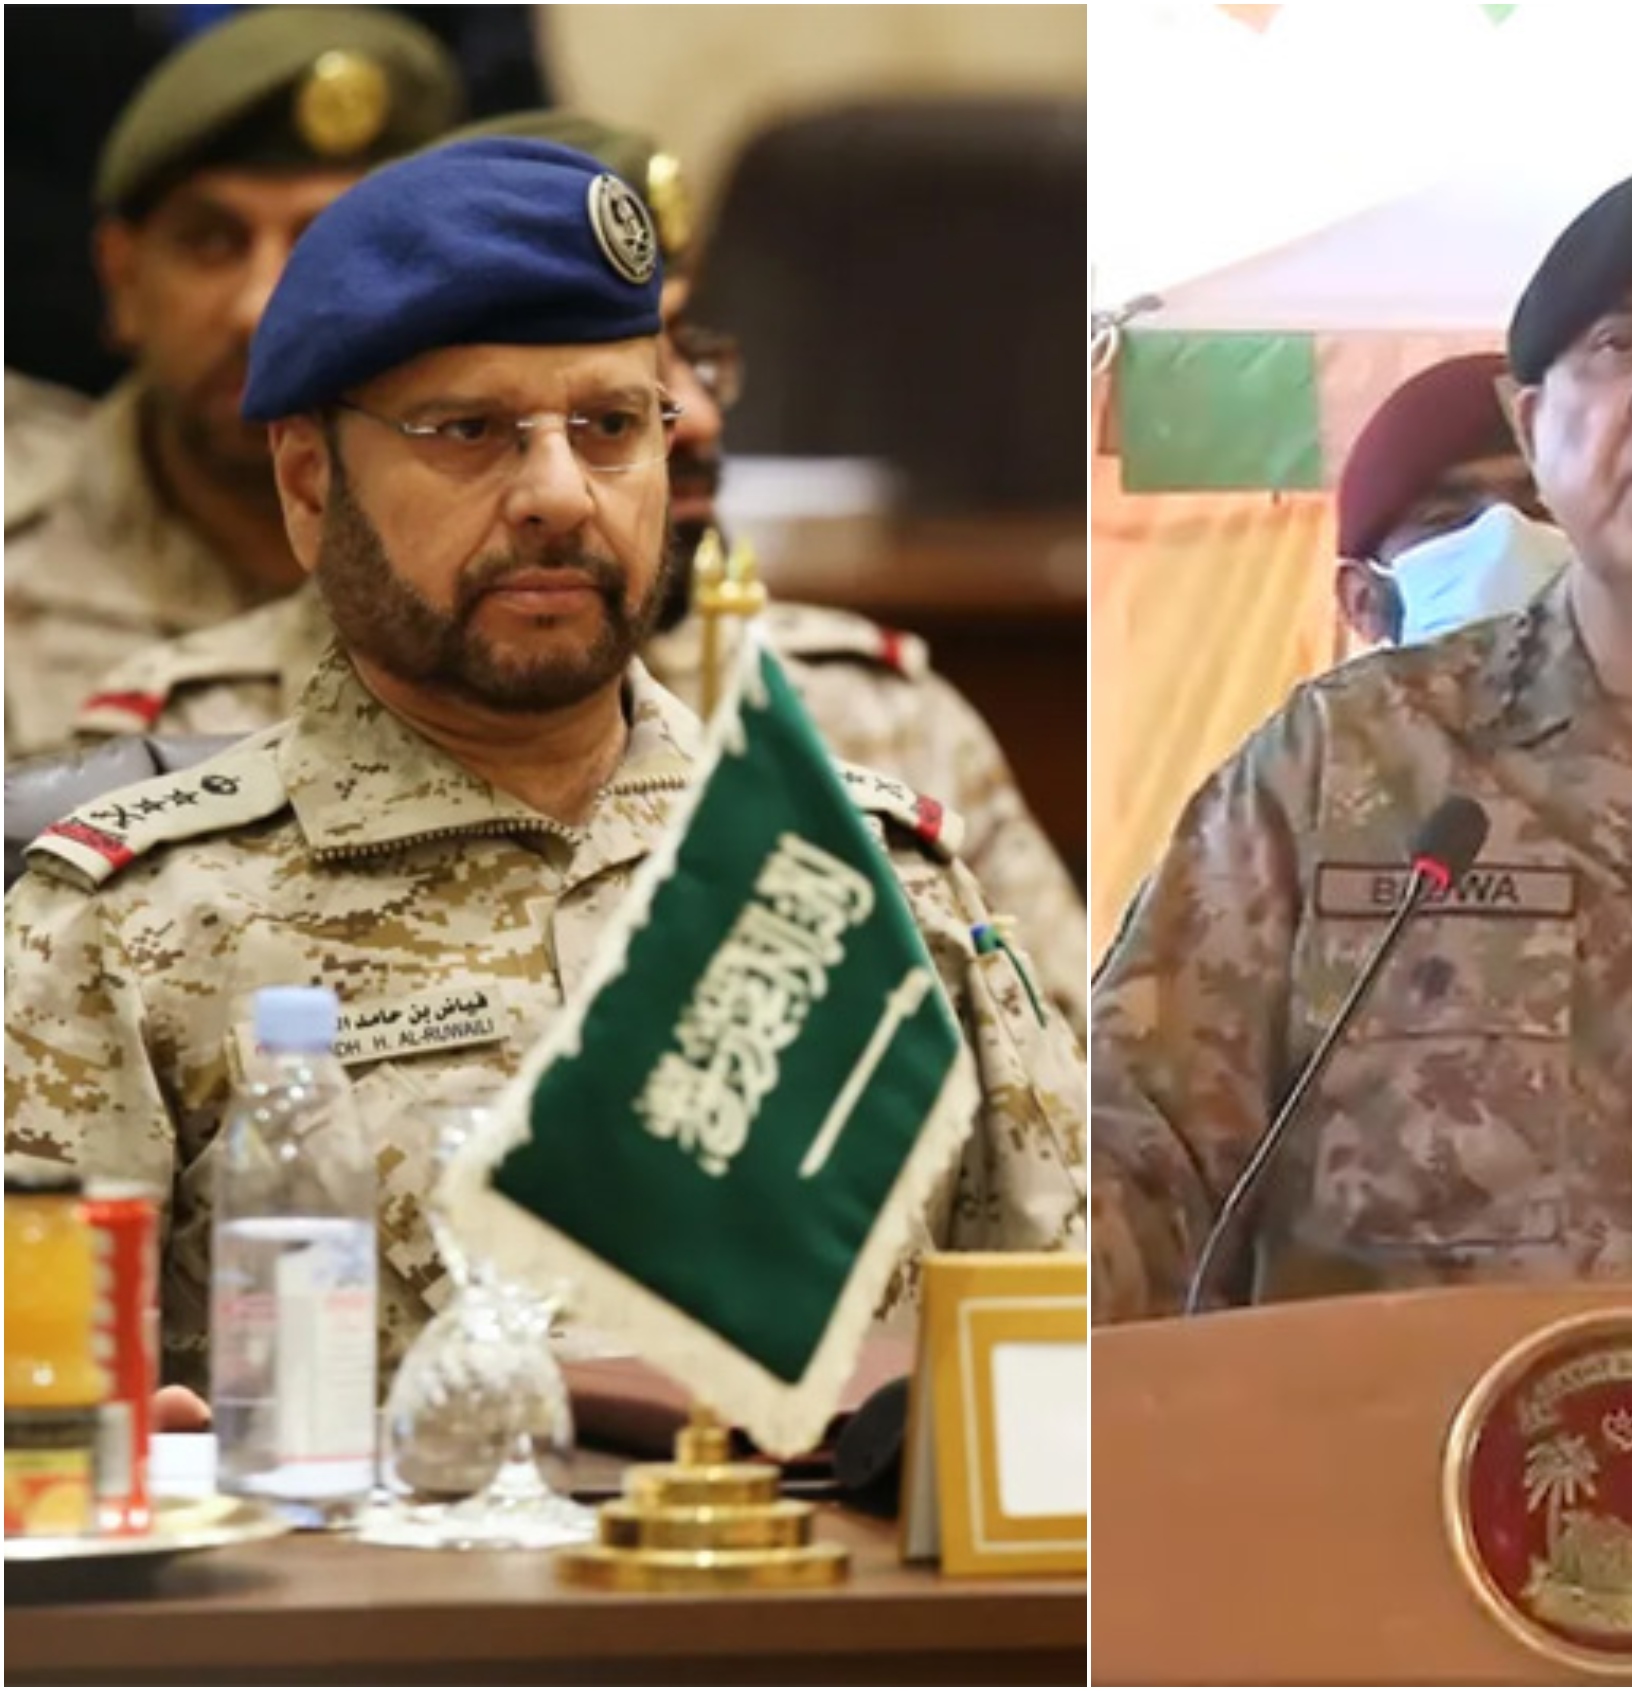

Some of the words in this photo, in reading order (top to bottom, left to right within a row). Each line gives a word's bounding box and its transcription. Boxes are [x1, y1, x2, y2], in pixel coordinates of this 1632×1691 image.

[354, 1007, 402, 1029] حامد
[407, 1002, 431, 1025] بن
[398, 1018, 494, 1046] AL-RUWAILI
